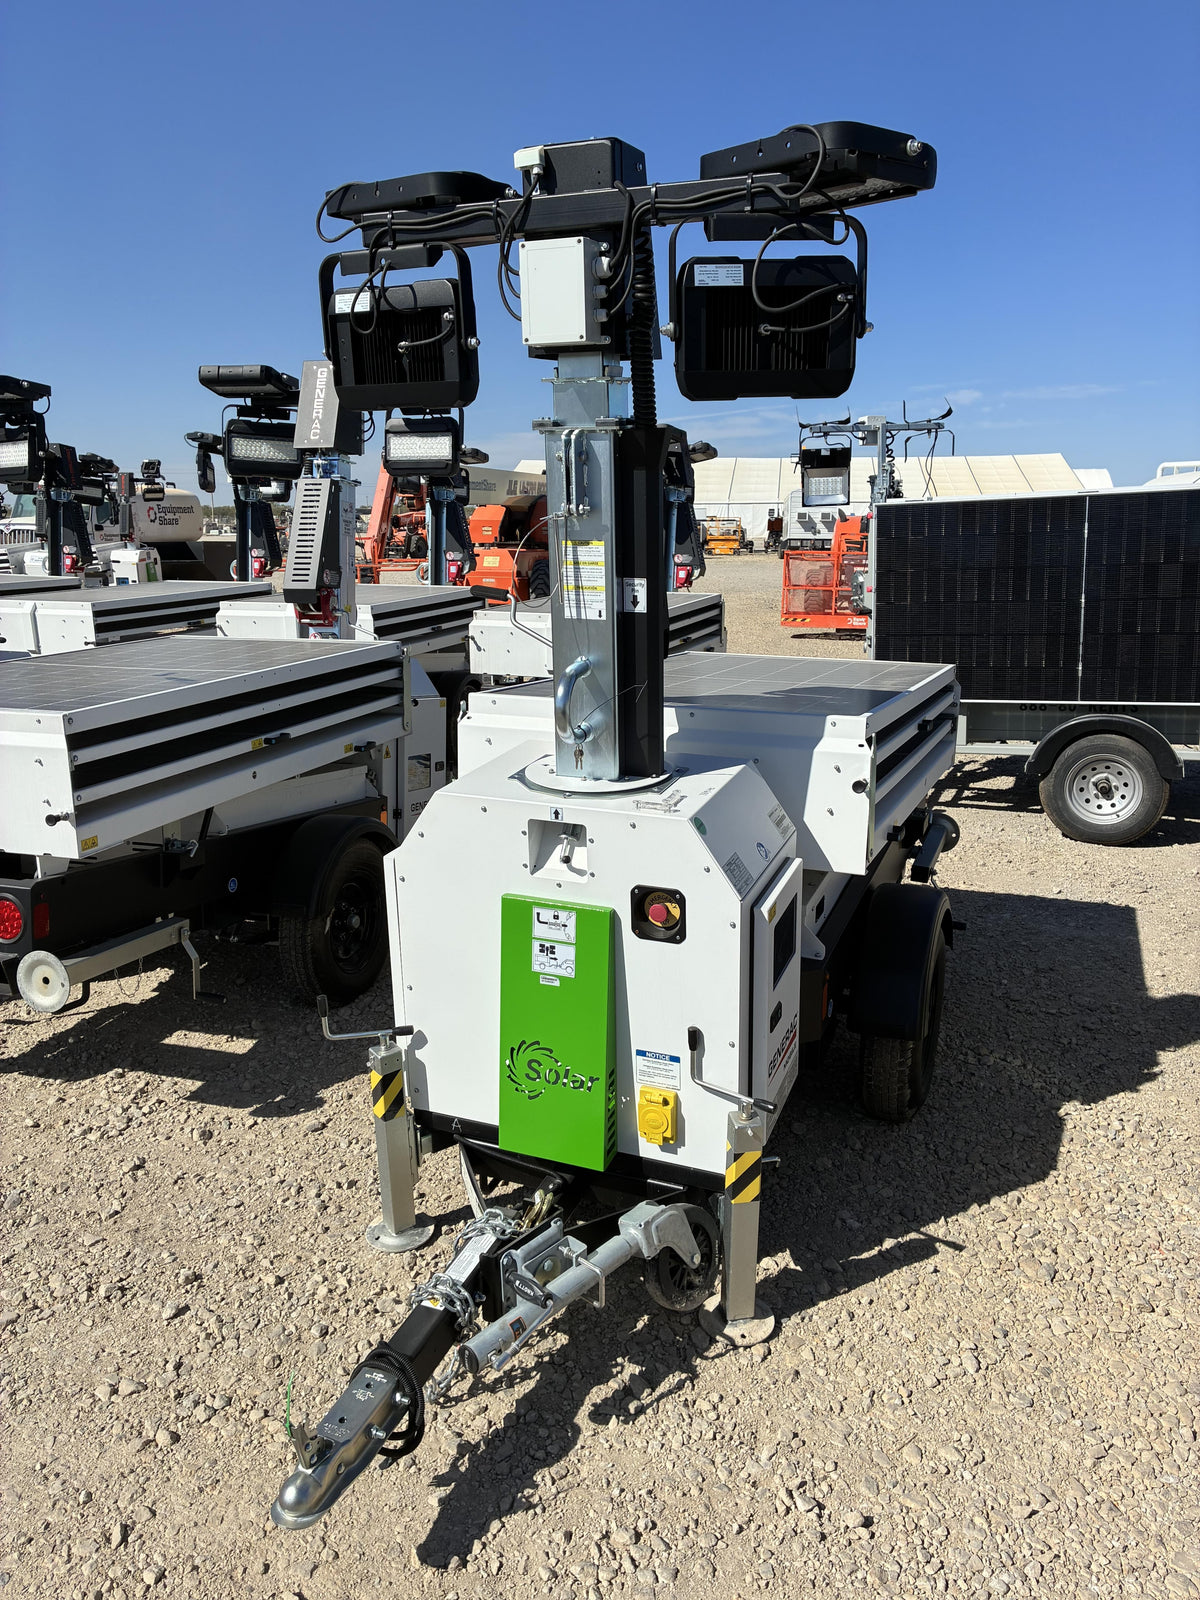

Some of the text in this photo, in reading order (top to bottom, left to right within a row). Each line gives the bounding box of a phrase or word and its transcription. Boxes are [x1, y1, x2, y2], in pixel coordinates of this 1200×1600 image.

[310, 367, 328, 440] GENERAC
[157, 504, 195, 516] Equipment
[158, 516, 180, 526] Share
[648, 894, 678, 910] EMERGENCY
[768, 1012, 798, 1078] GENERAC
[645, 1051, 670, 1061] NOTICE
[525, 1058, 600, 1093] Solar
